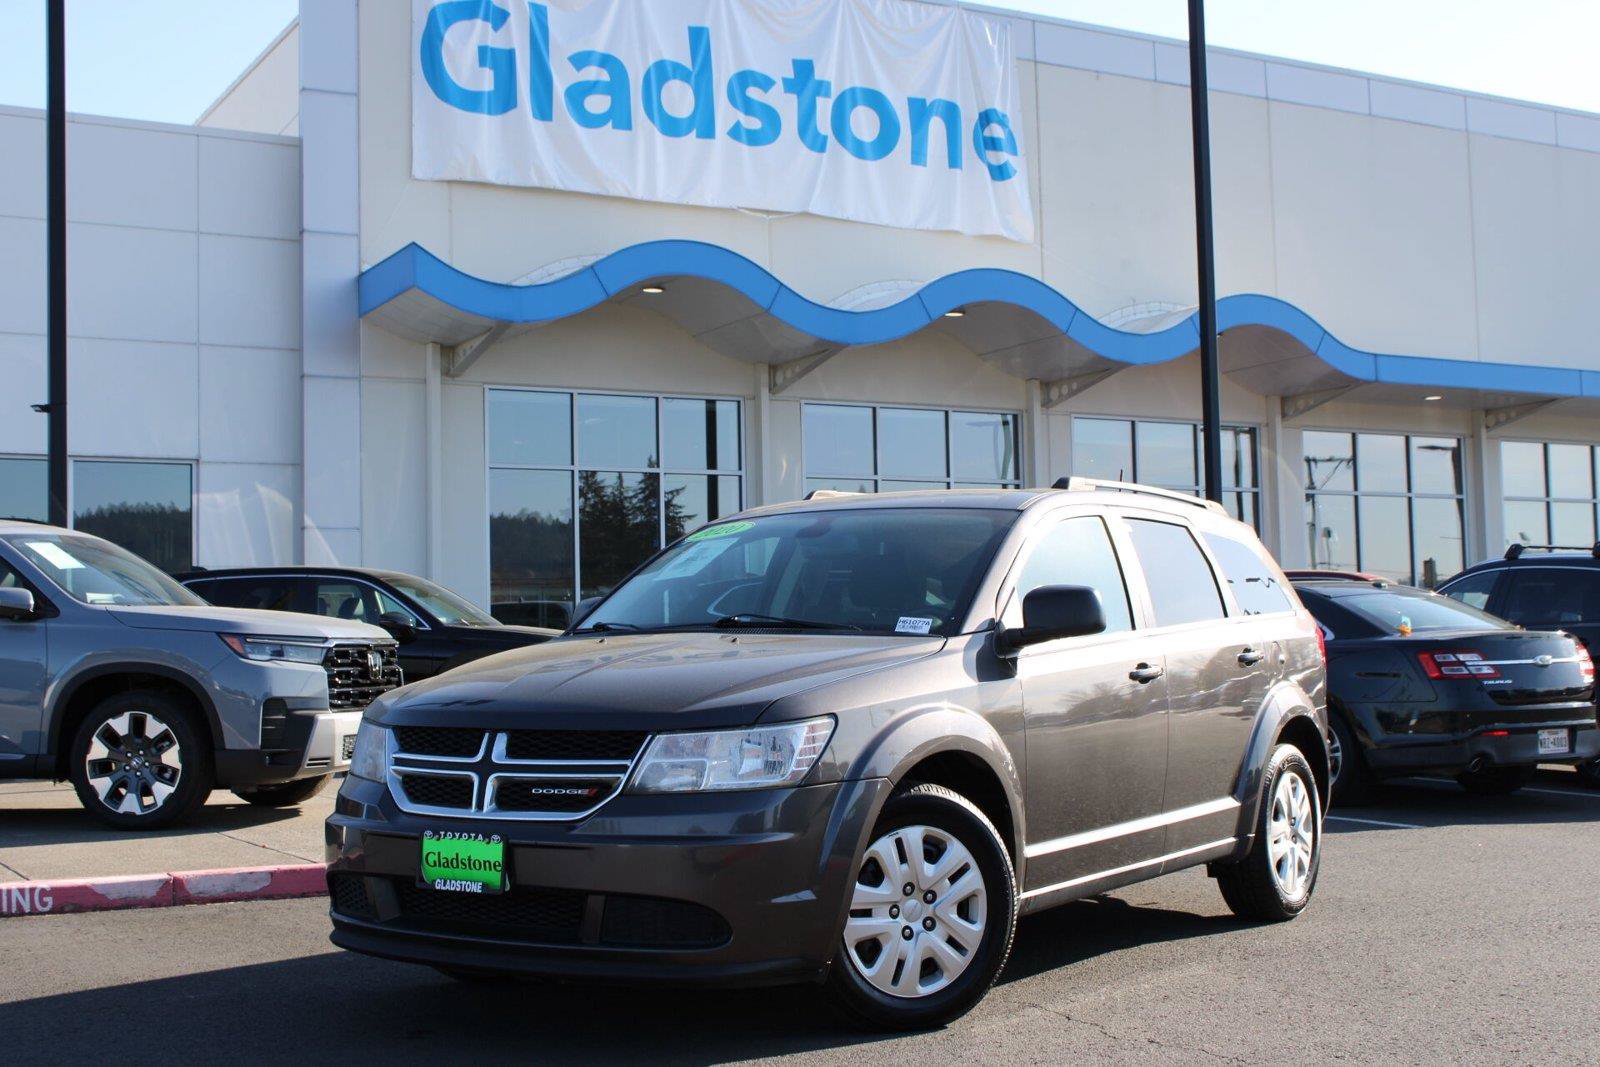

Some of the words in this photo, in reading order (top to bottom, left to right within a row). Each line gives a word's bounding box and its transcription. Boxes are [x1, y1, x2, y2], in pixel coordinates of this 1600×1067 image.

[420, 0, 1019, 181] Gladstone
[531, 787, 589, 795] DODGE
[439, 831, 484, 842] TOYOTA
[424, 851, 503, 873] Gladstone
[434, 878, 483, 893] GLADSTONE
